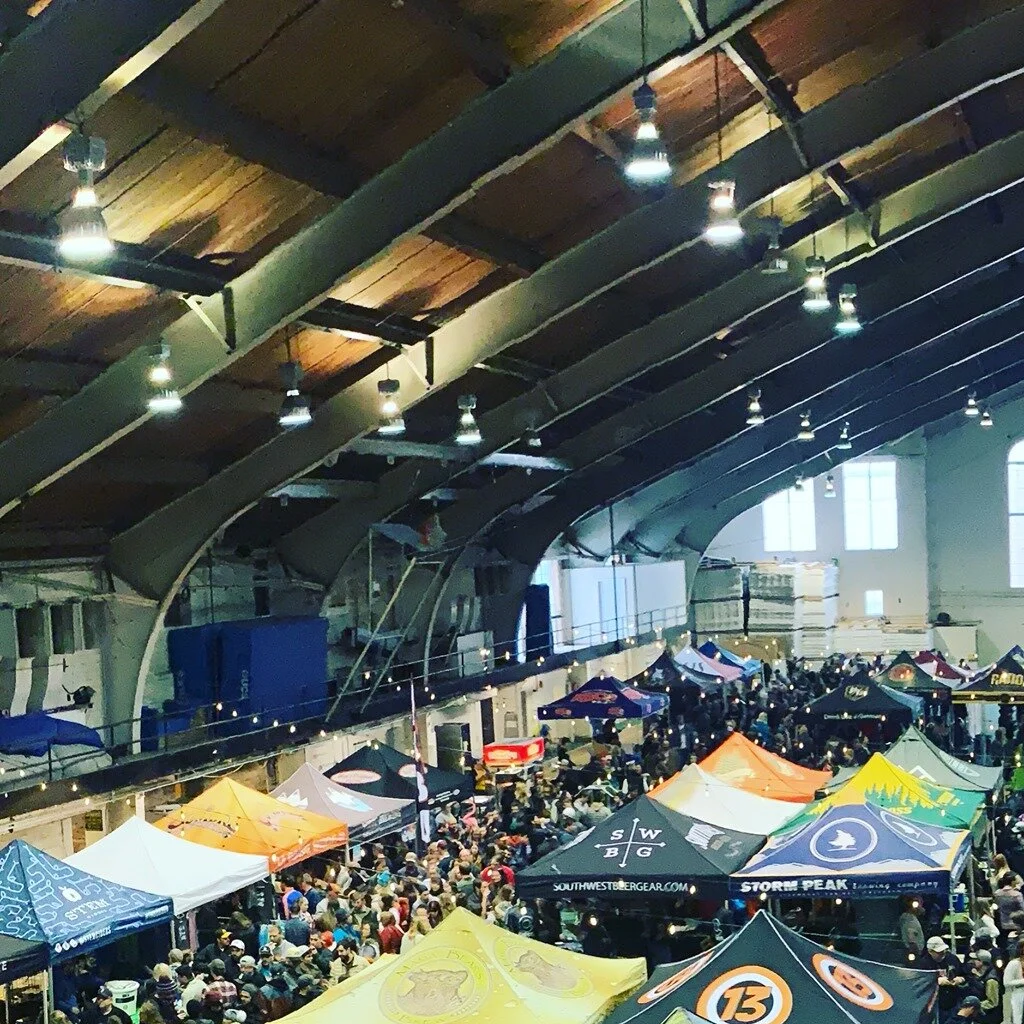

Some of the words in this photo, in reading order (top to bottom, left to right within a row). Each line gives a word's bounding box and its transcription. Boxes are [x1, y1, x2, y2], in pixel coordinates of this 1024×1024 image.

[610, 829, 625, 841] S
[638, 827, 663, 841] W
[603, 848, 620, 859] B
[636, 847, 653, 859] G
[740, 880, 798, 894] STORM
[801, 879, 849, 891] PEAK
[719, 986, 774, 1023] 13
